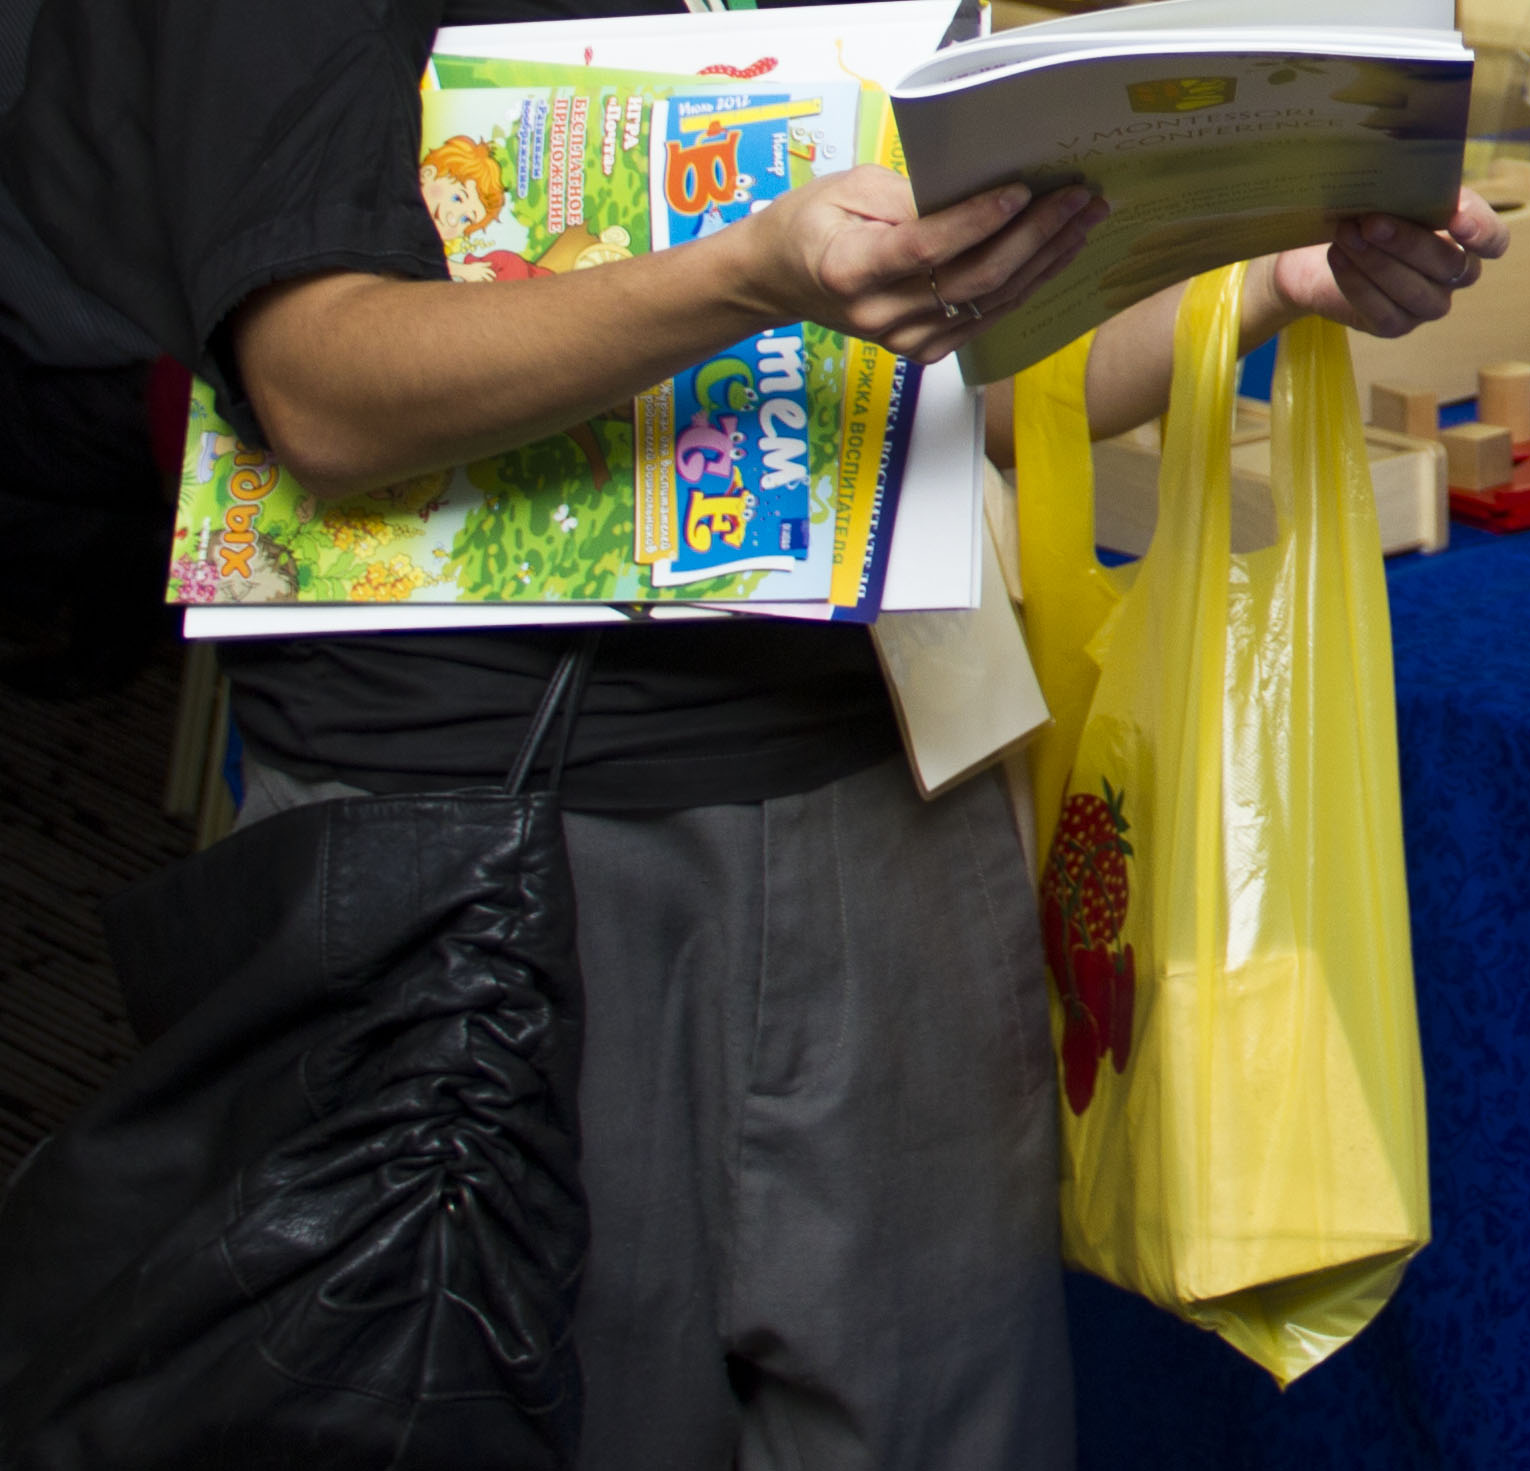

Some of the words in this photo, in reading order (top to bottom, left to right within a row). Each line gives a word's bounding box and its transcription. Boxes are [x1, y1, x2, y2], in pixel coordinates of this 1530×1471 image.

[602, 95, 621, 176] «Почта»
[623, 97, 642, 150] ИГРА
[1093, 108, 1315, 141] MONTESSORI
[1116, 119, 1346, 151] CONFERENCE
[549, 98, 569, 232] ПРИЛОЖЕНИЕ
[567, 97, 589, 225] БЕСПЛАТНОЕ
